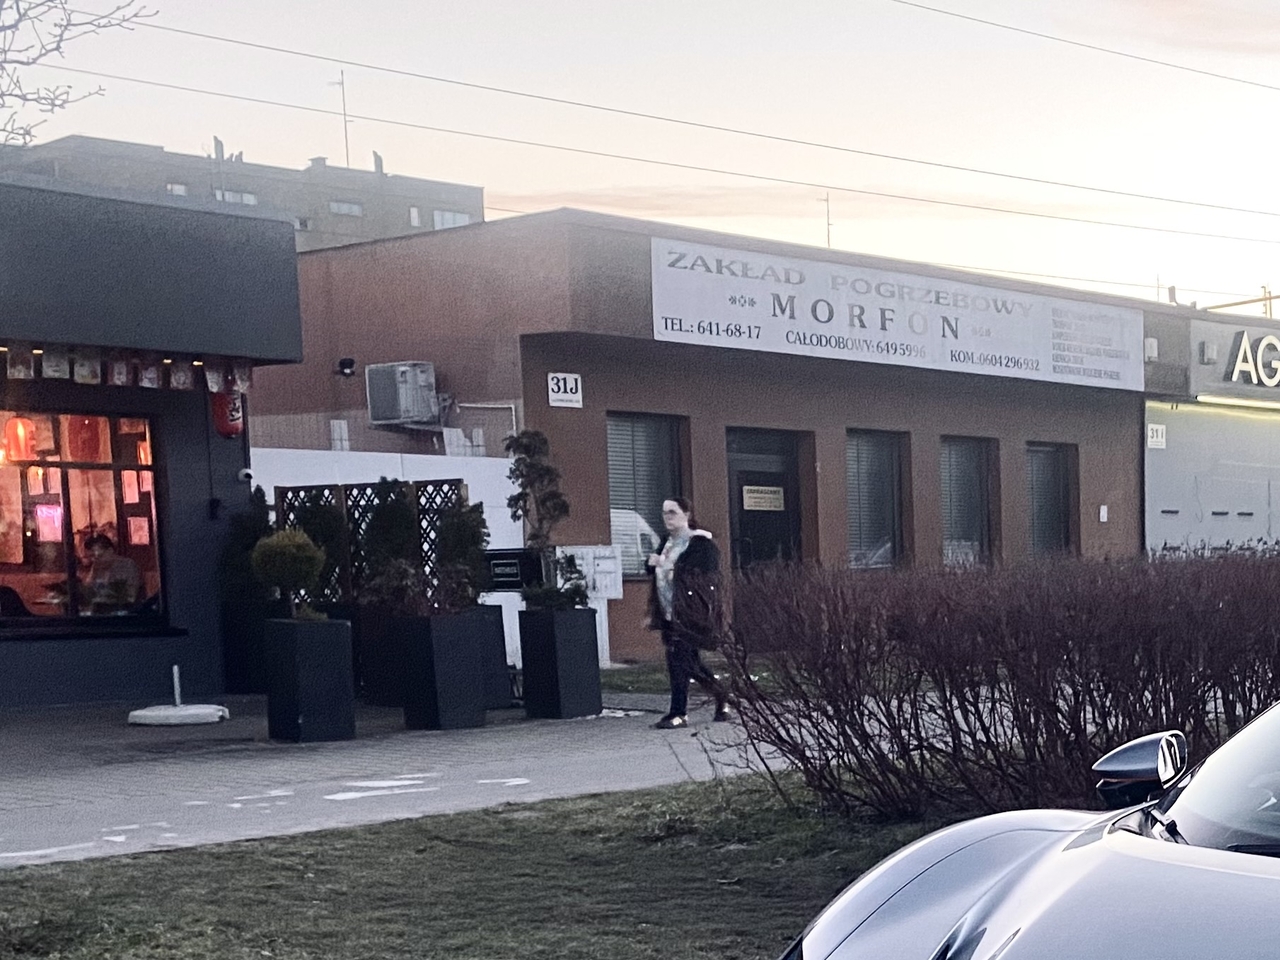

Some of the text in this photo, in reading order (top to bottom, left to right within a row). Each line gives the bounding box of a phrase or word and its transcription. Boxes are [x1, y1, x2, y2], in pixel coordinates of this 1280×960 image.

[667, 251, 1033, 317] ZAKŁAD POGRZEBOWY
[697, 320, 761, 340] 641-68-17
[771, 292, 960, 340] MORFON
[551, 376, 579, 395] 31J
